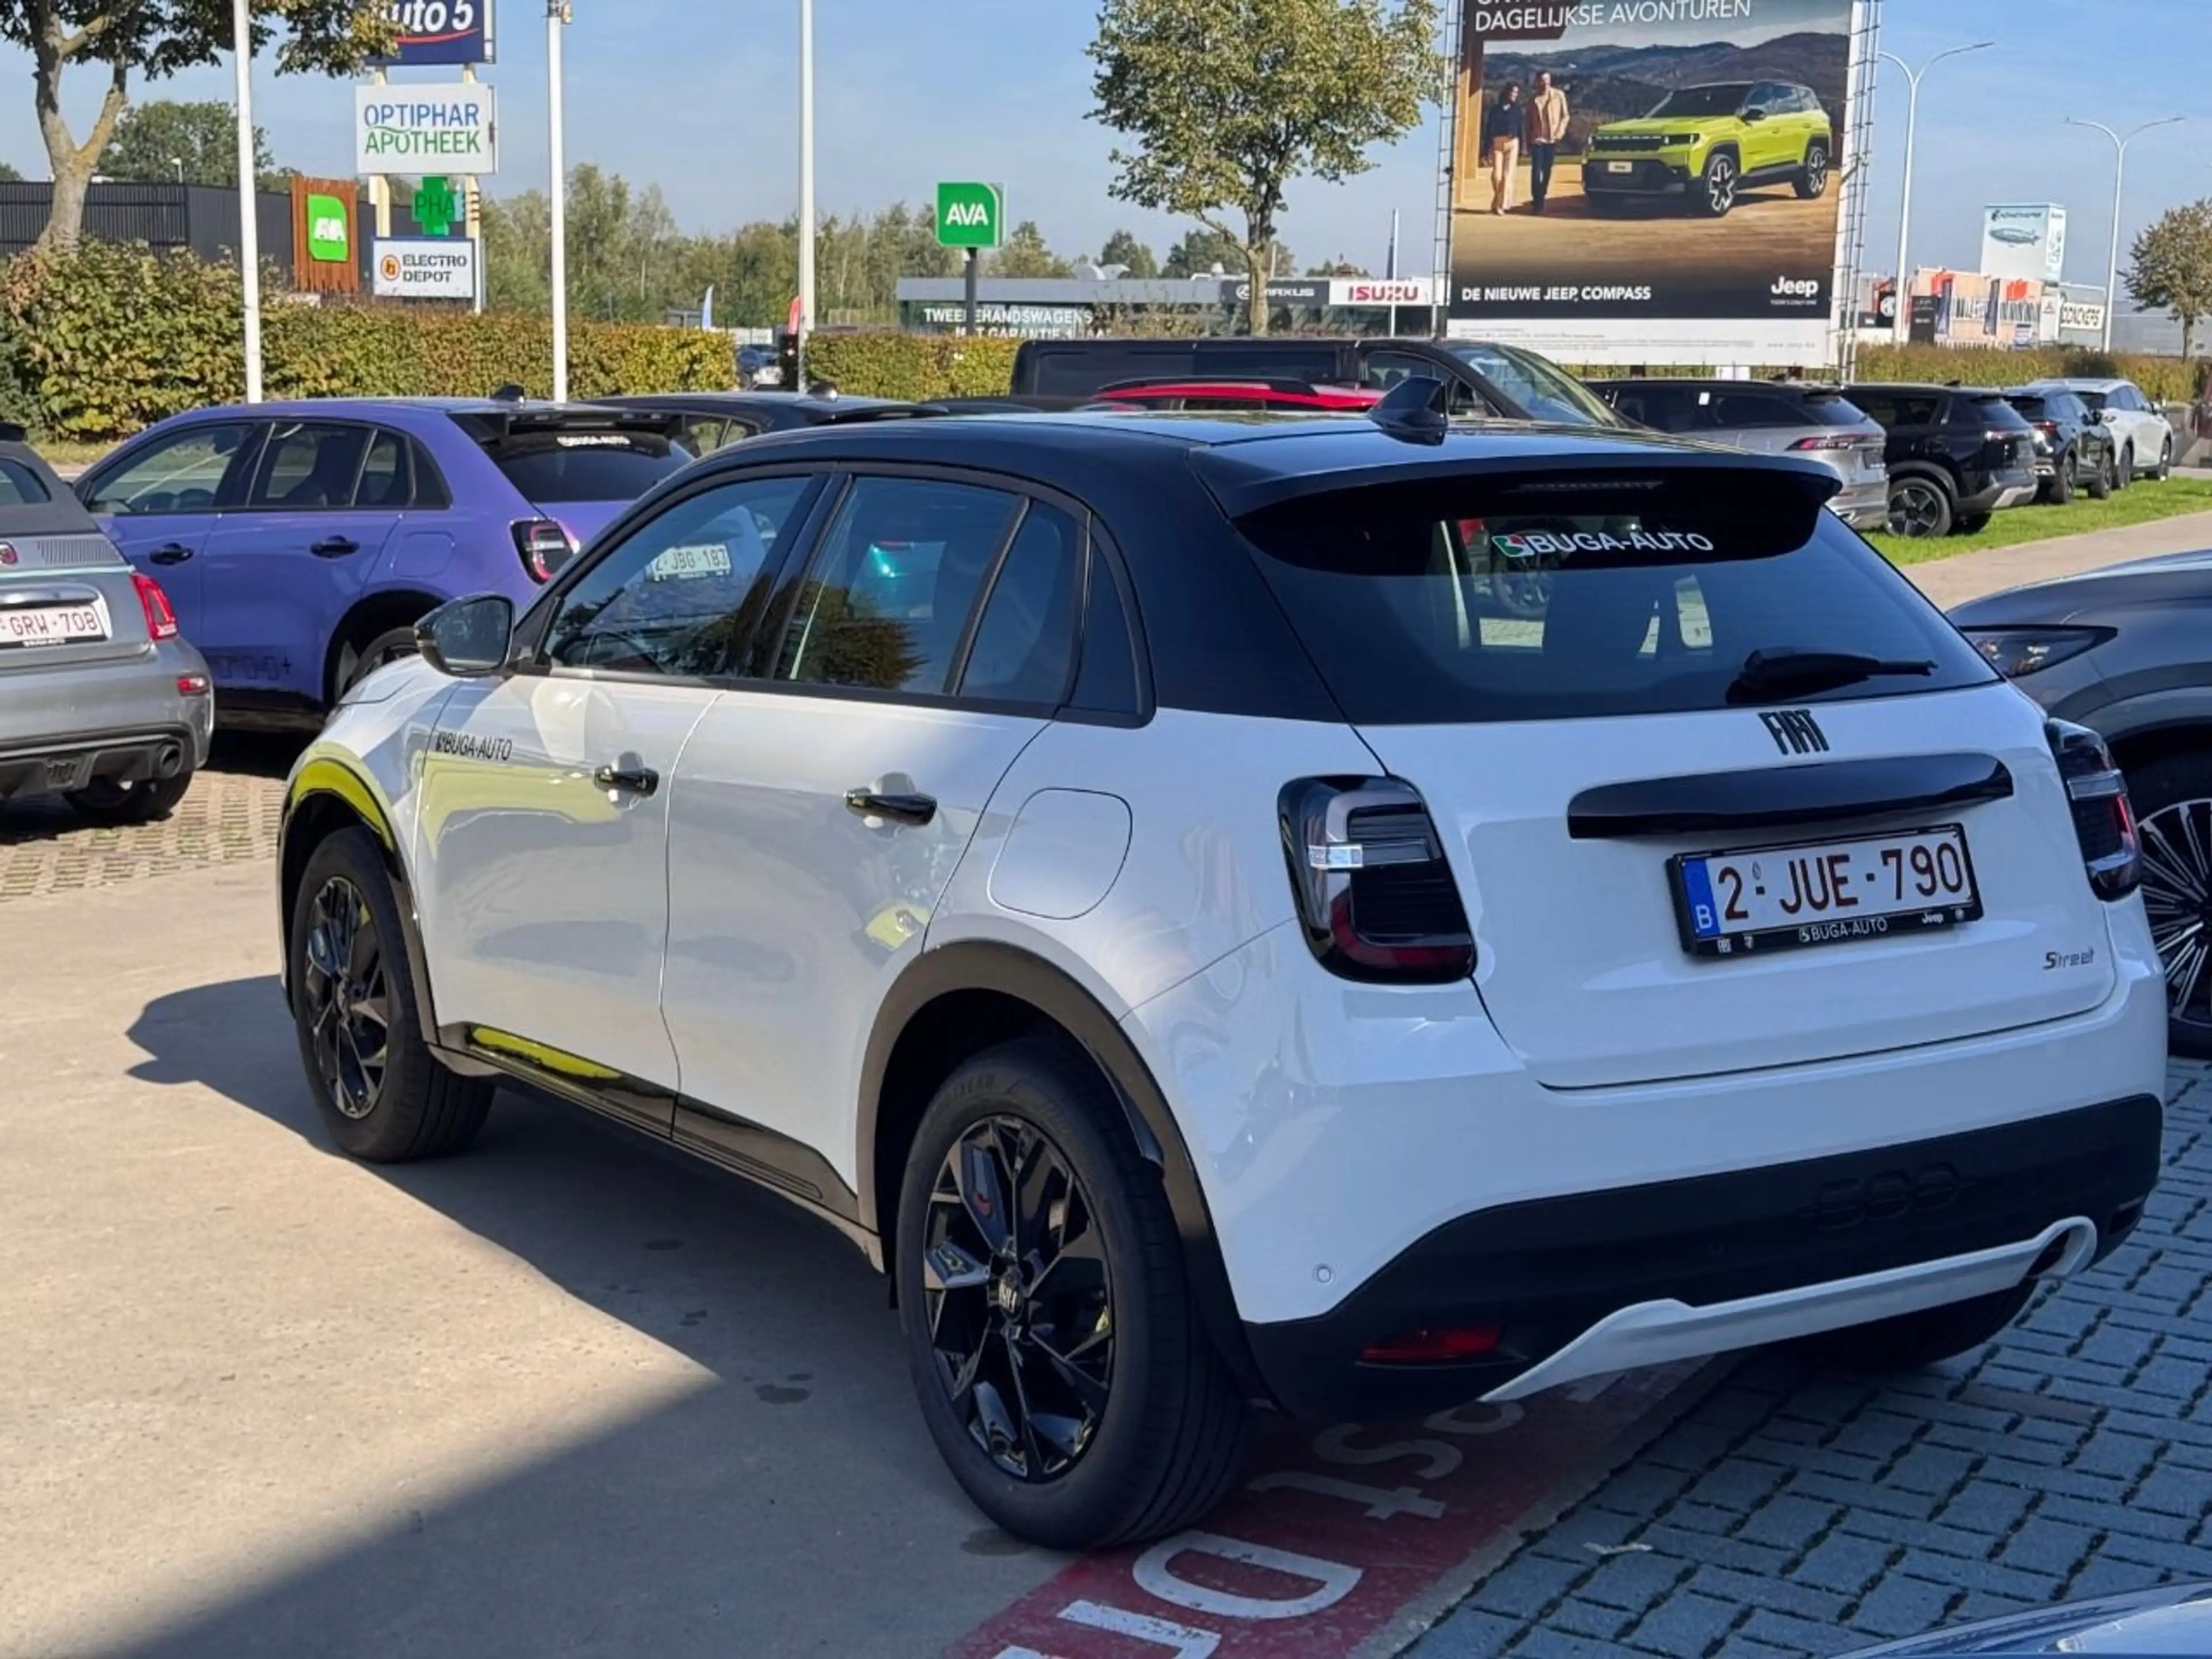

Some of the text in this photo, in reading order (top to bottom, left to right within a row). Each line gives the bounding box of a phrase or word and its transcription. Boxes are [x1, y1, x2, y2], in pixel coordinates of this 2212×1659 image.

[379, 0, 474, 32] uto 5
[1475, 0, 1751, 32] DAGELIJKSE AVONTUREN
[364, 103, 479, 127] OPTIPHAR
[365, 130, 480, 154] APOTHEEK
[945, 202, 989, 226] AVA
[403, 254, 467, 267] ELECTRO
[403, 271, 452, 283] DEPOT
[1771, 276, 1819, 298] Jeep
[1348, 286, 1418, 301] ISUZU
[1462, 287, 1480, 301] DE
[1484, 287, 1541, 301] NIEUWE
[1581, 286, 1652, 300] COMPASS
[1524, 532, 1714, 554] BUGA-AUTO
[1758, 709, 1830, 756] FIAT
[1695, 904, 1713, 929] B
[1811, 917, 1888, 941] BUGA-AUTO
